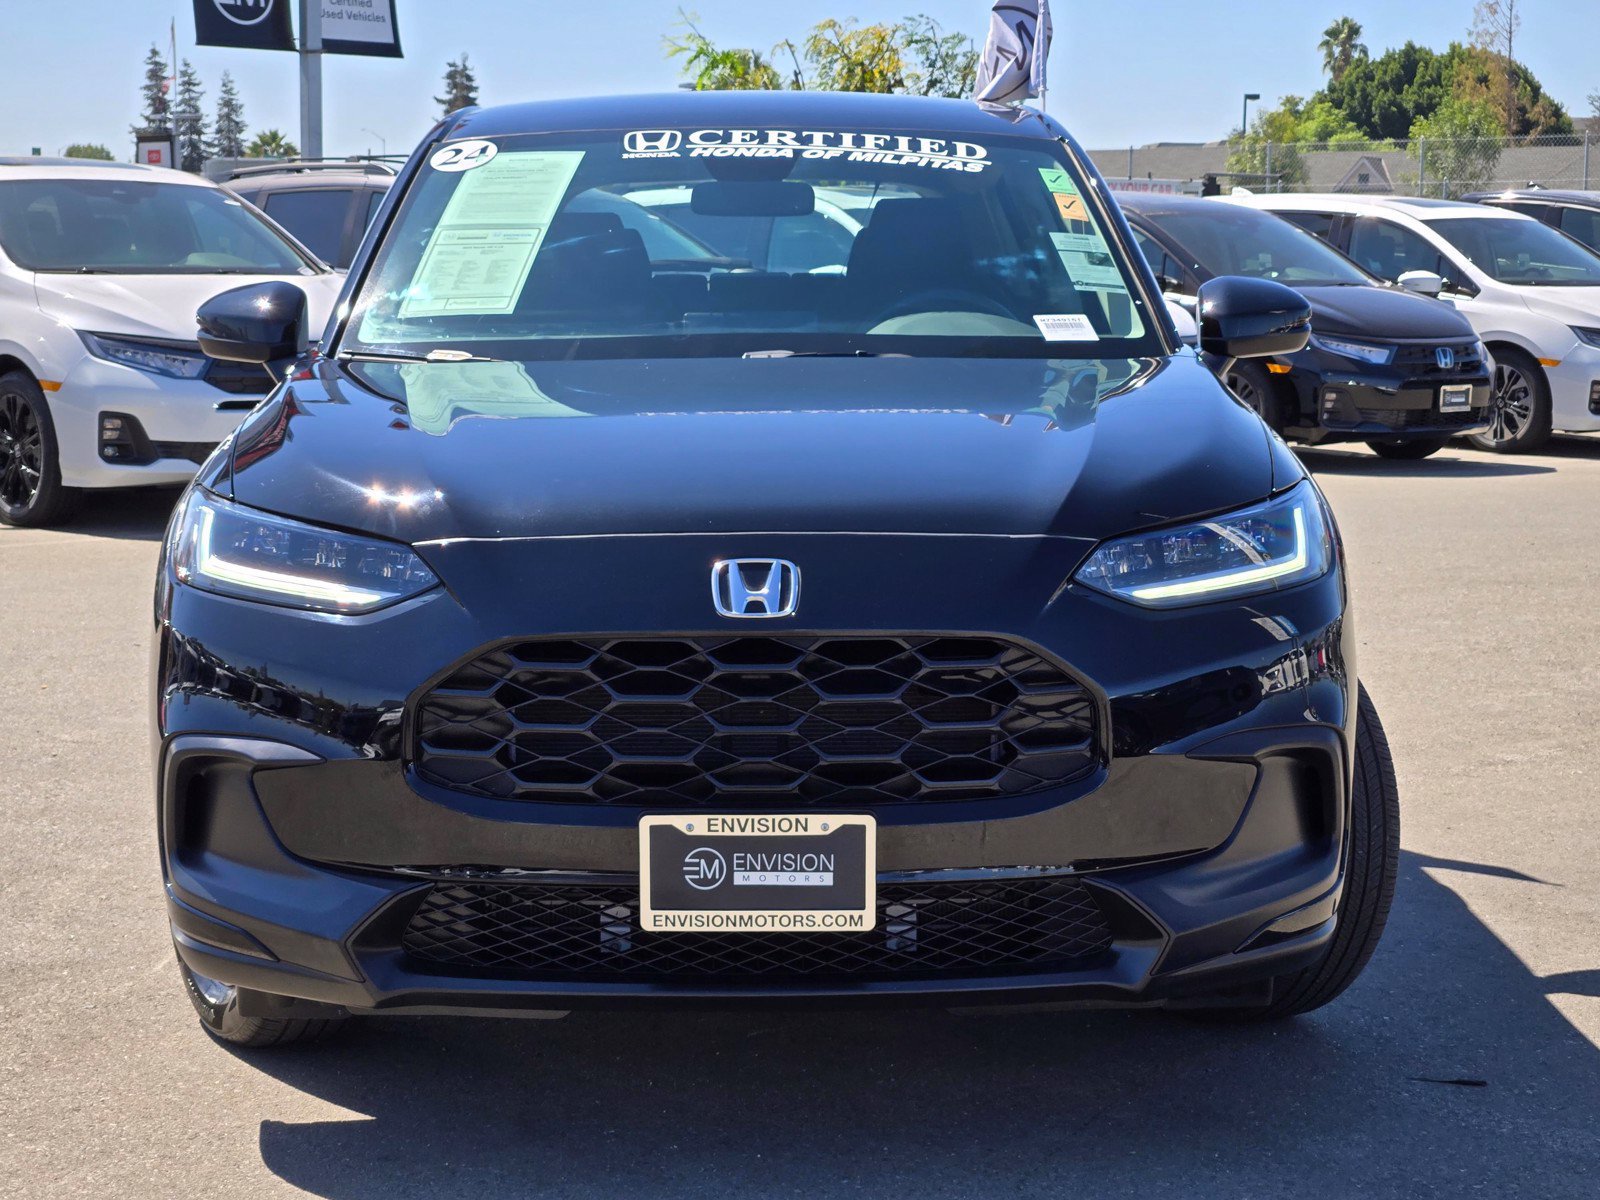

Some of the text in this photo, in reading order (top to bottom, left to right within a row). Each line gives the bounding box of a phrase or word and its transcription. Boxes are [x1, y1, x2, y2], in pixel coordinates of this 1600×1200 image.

[345, 10, 386, 23] Vehicles
[688, 129, 988, 161] CERTIFIED
[437, 144, 490, 166] 24
[689, 147, 986, 173] HONDA OF MILPITAS
[706, 817, 810, 833] ENVISION
[732, 853, 835, 872] ENVISION
[741, 874, 826, 883] MOTORS
[652, 914, 864, 928] ENVISIONMOTORS.COM
